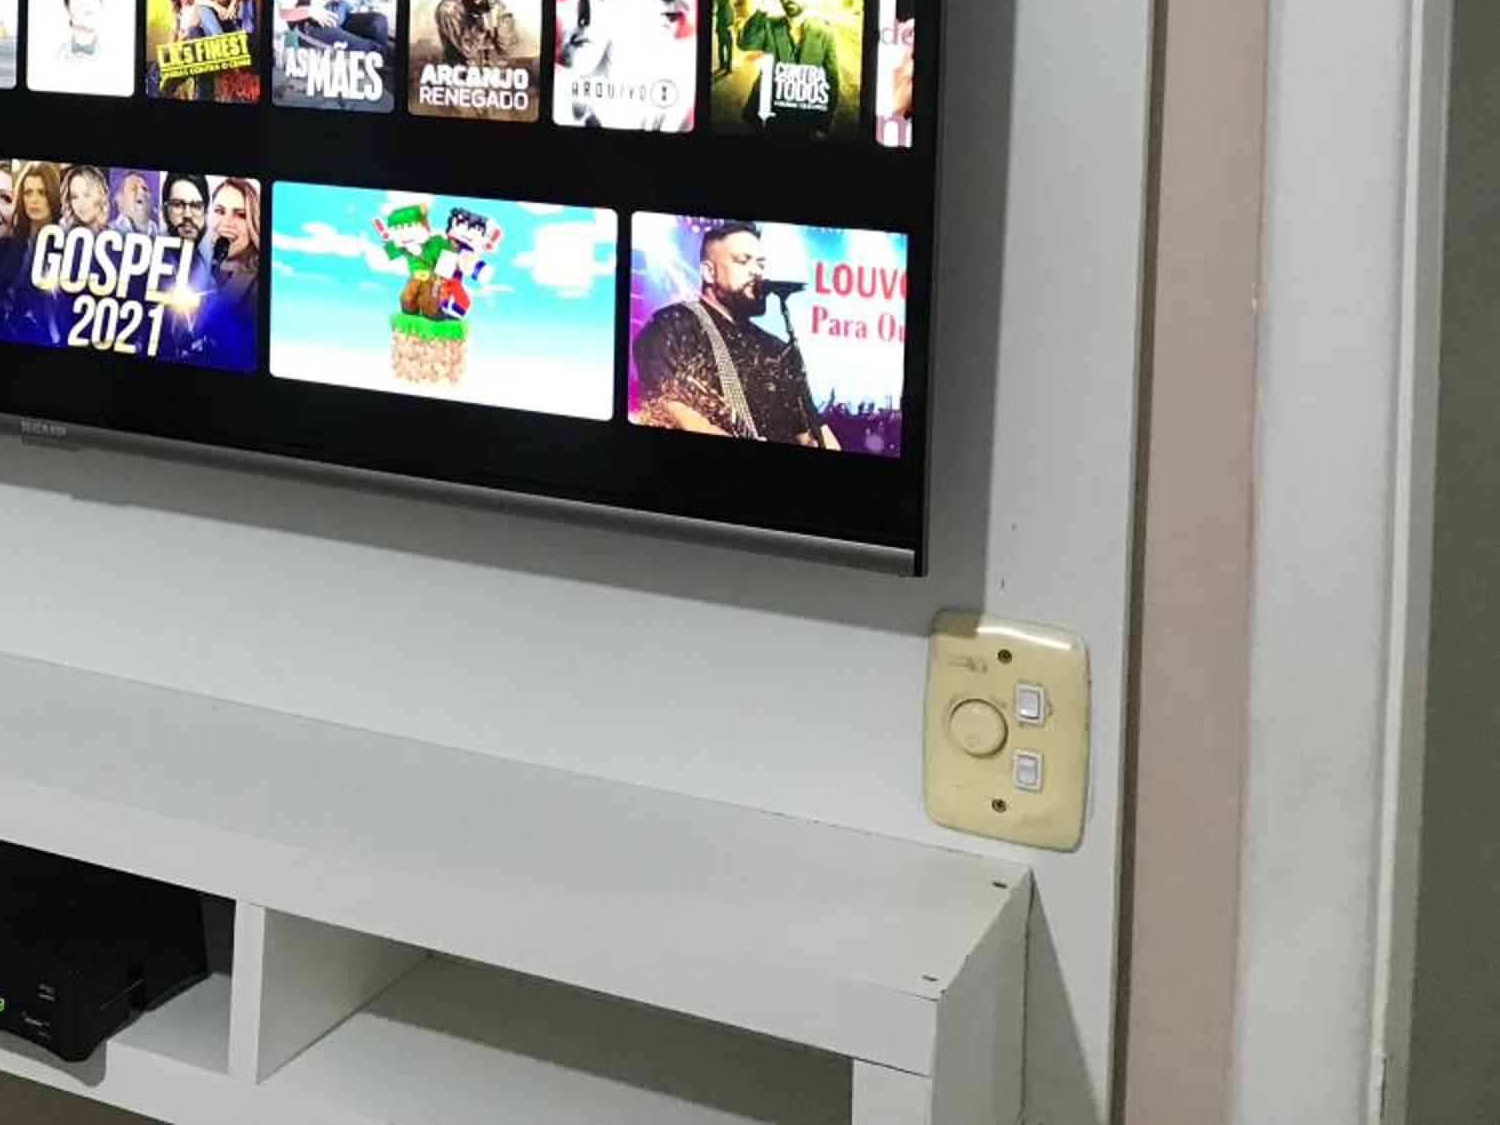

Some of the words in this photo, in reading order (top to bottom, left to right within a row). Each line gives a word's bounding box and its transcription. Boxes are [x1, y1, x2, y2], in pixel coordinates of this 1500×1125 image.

[307, 42, 384, 101] MÃES
[421, 64, 528, 89] ARCANJO
[419, 86, 528, 110] RENEGADO
[31, 225, 200, 306] GOSPEL
[67, 294, 165, 357] 2021
[811, 305, 867, 339] Para
